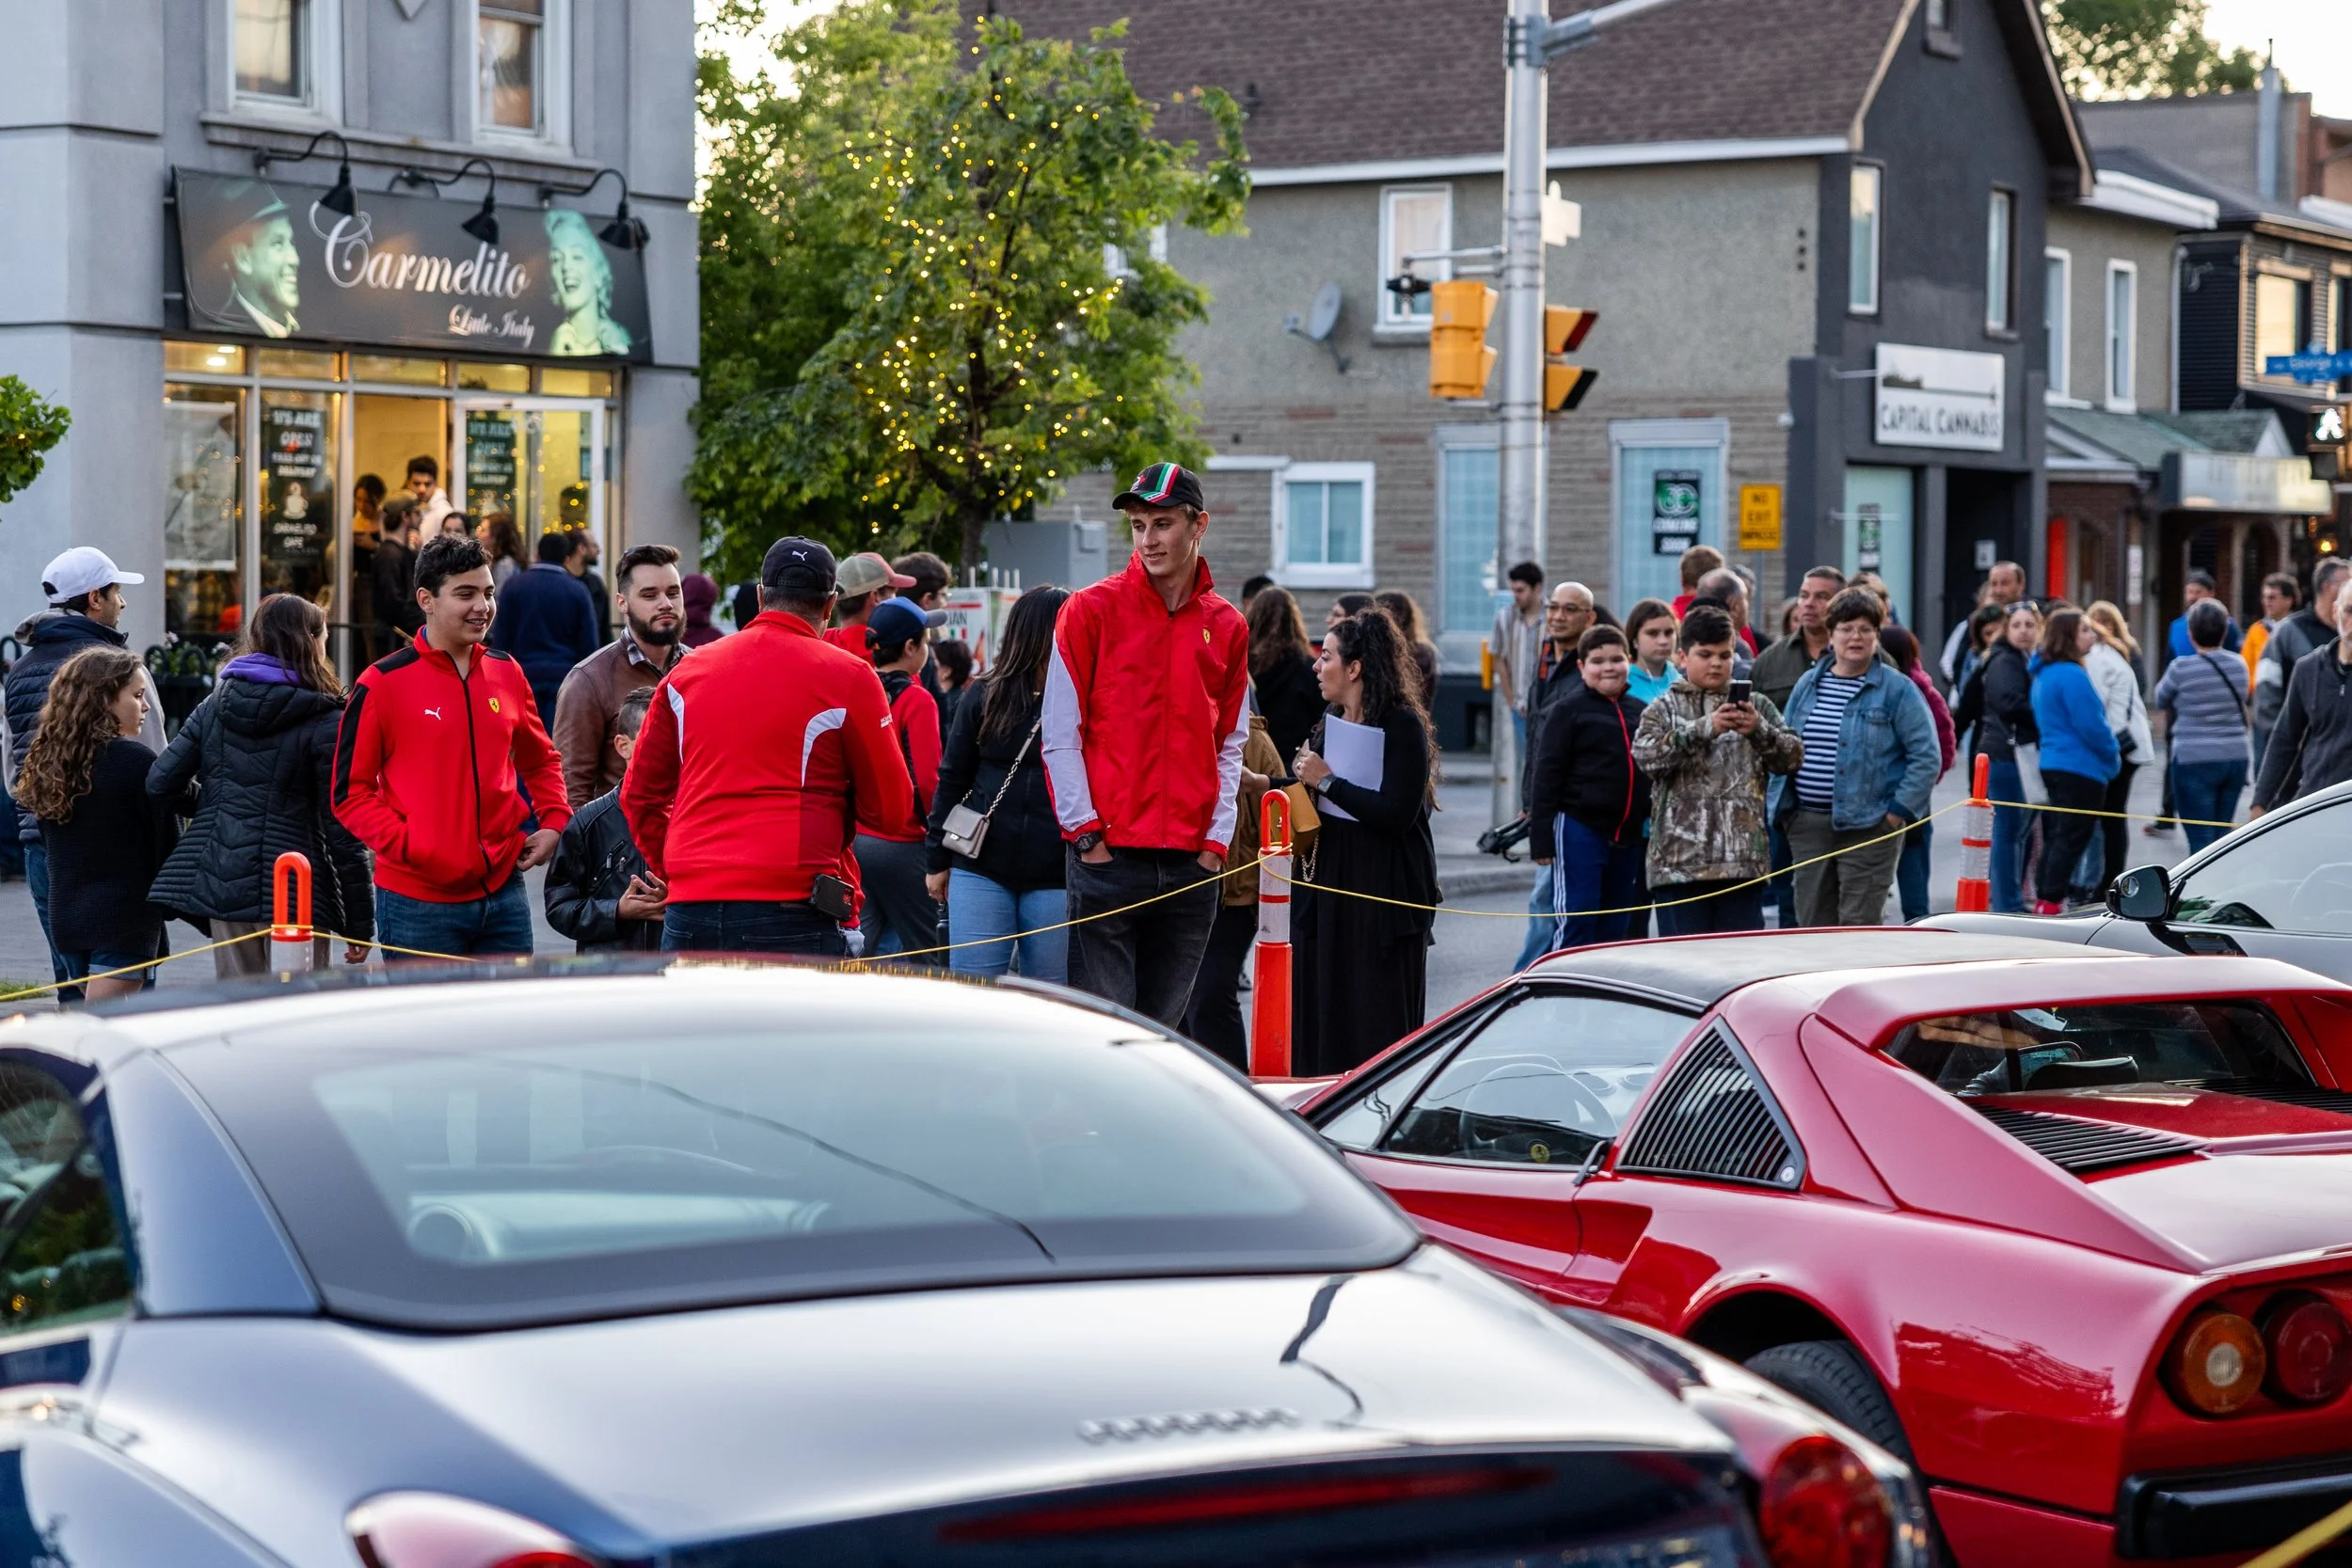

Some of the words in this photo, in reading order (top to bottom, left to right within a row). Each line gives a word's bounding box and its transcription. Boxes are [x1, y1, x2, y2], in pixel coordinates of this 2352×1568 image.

[309, 199, 531, 299] Carmelito
[448, 304, 492, 336] Little
[493, 309, 535, 349] Italy
[279, 431, 314, 447] OPEN
[1752, 492, 1769, 505] NO
